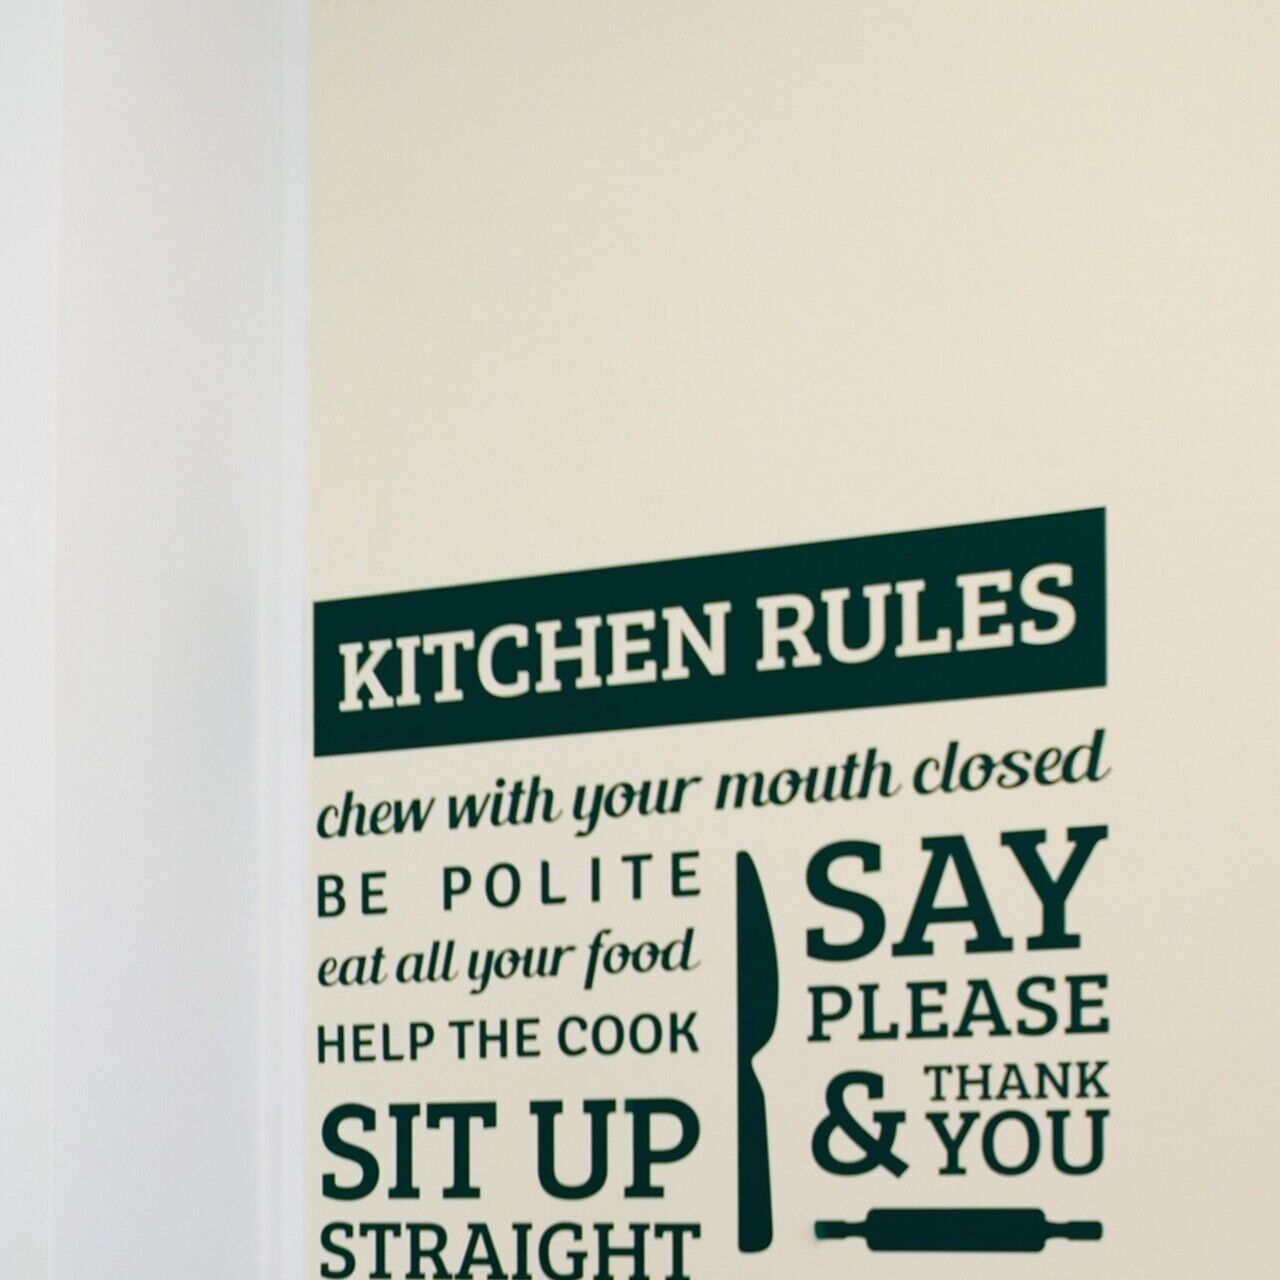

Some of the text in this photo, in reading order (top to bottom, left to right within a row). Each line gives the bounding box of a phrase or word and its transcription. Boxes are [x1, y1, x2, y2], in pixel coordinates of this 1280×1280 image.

[338, 563, 1076, 712] KITCHEN RULES
[316, 728, 1111, 839] chew with your mouth closed
[317, 850, 701, 918] BE POLITE
[805, 824, 1109, 962] SAY
[317, 927, 695, 995] eat all your food
[317, 1011, 699, 1064] HELP THE COOK
[807, 974, 1110, 1043] PLEASE
[811, 1070, 1110, 1179] & YOU
[923, 1061, 1109, 1102] THANK
[321, 1097, 701, 1201] SIT UP
